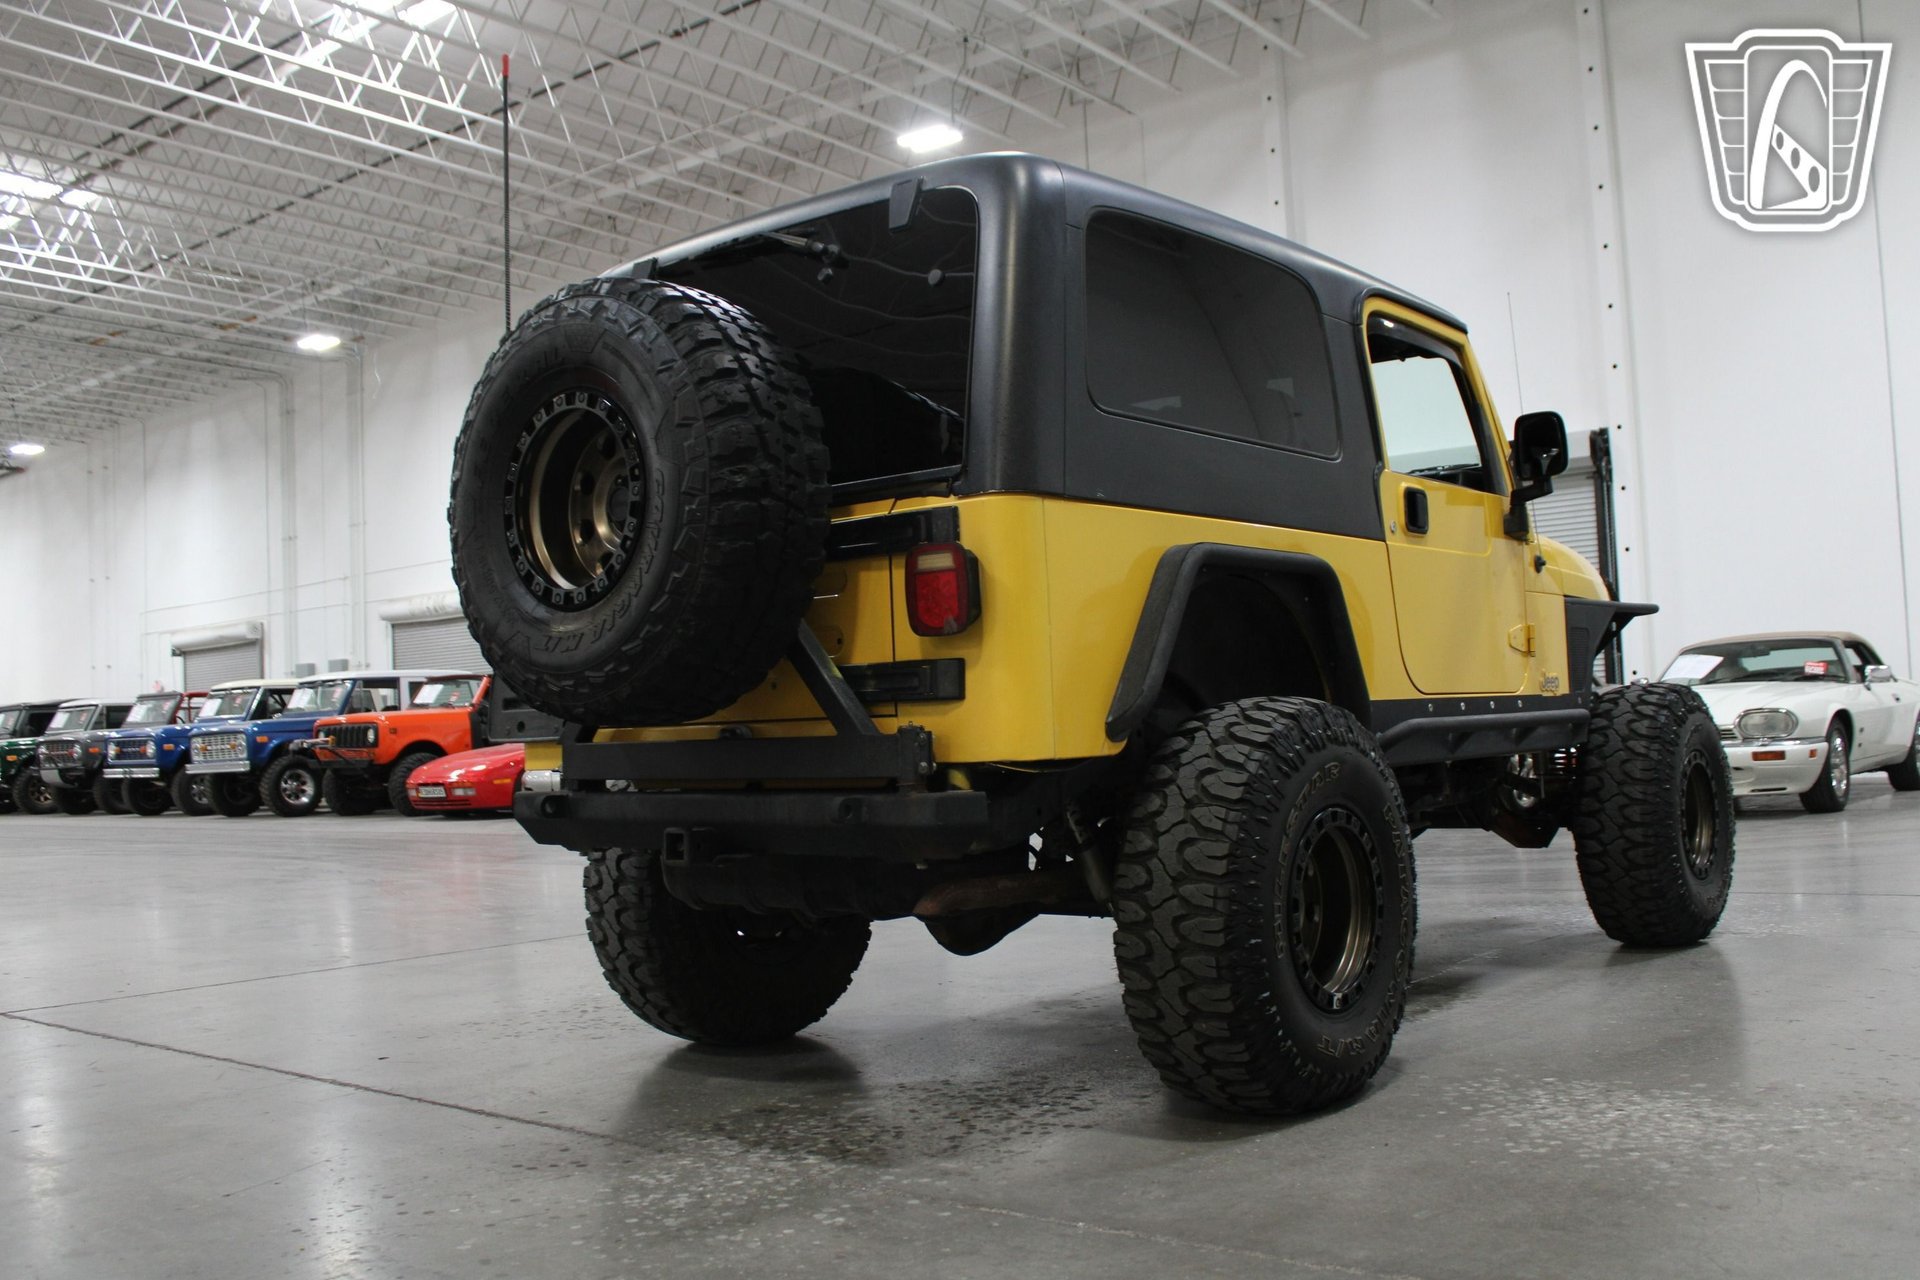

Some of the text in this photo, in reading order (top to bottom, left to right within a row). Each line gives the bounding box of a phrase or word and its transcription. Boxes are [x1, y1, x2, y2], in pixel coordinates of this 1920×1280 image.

[1540, 671, 1560, 692] Jeep
[1272, 761, 1342, 959] MILESTAR
[1316, 802, 1409, 1059] PATAGONIA M/T
